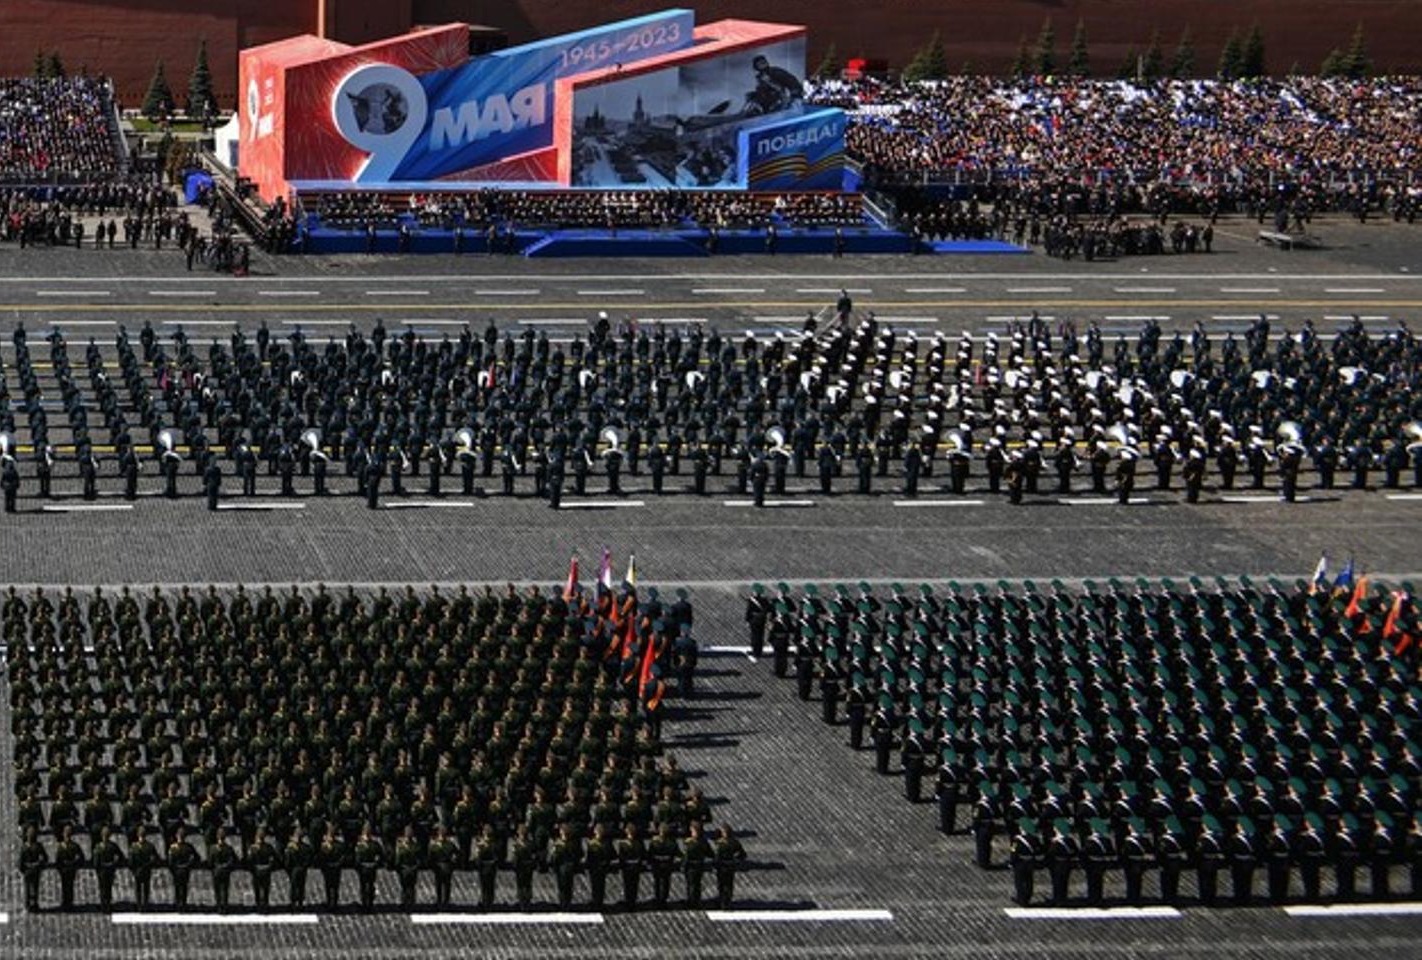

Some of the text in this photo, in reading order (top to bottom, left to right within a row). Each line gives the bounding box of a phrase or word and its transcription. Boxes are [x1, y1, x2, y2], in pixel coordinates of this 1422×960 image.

[332, 62, 546, 183] 9 МАЯ
[758, 122, 838, 155] ПОБЕДА!
